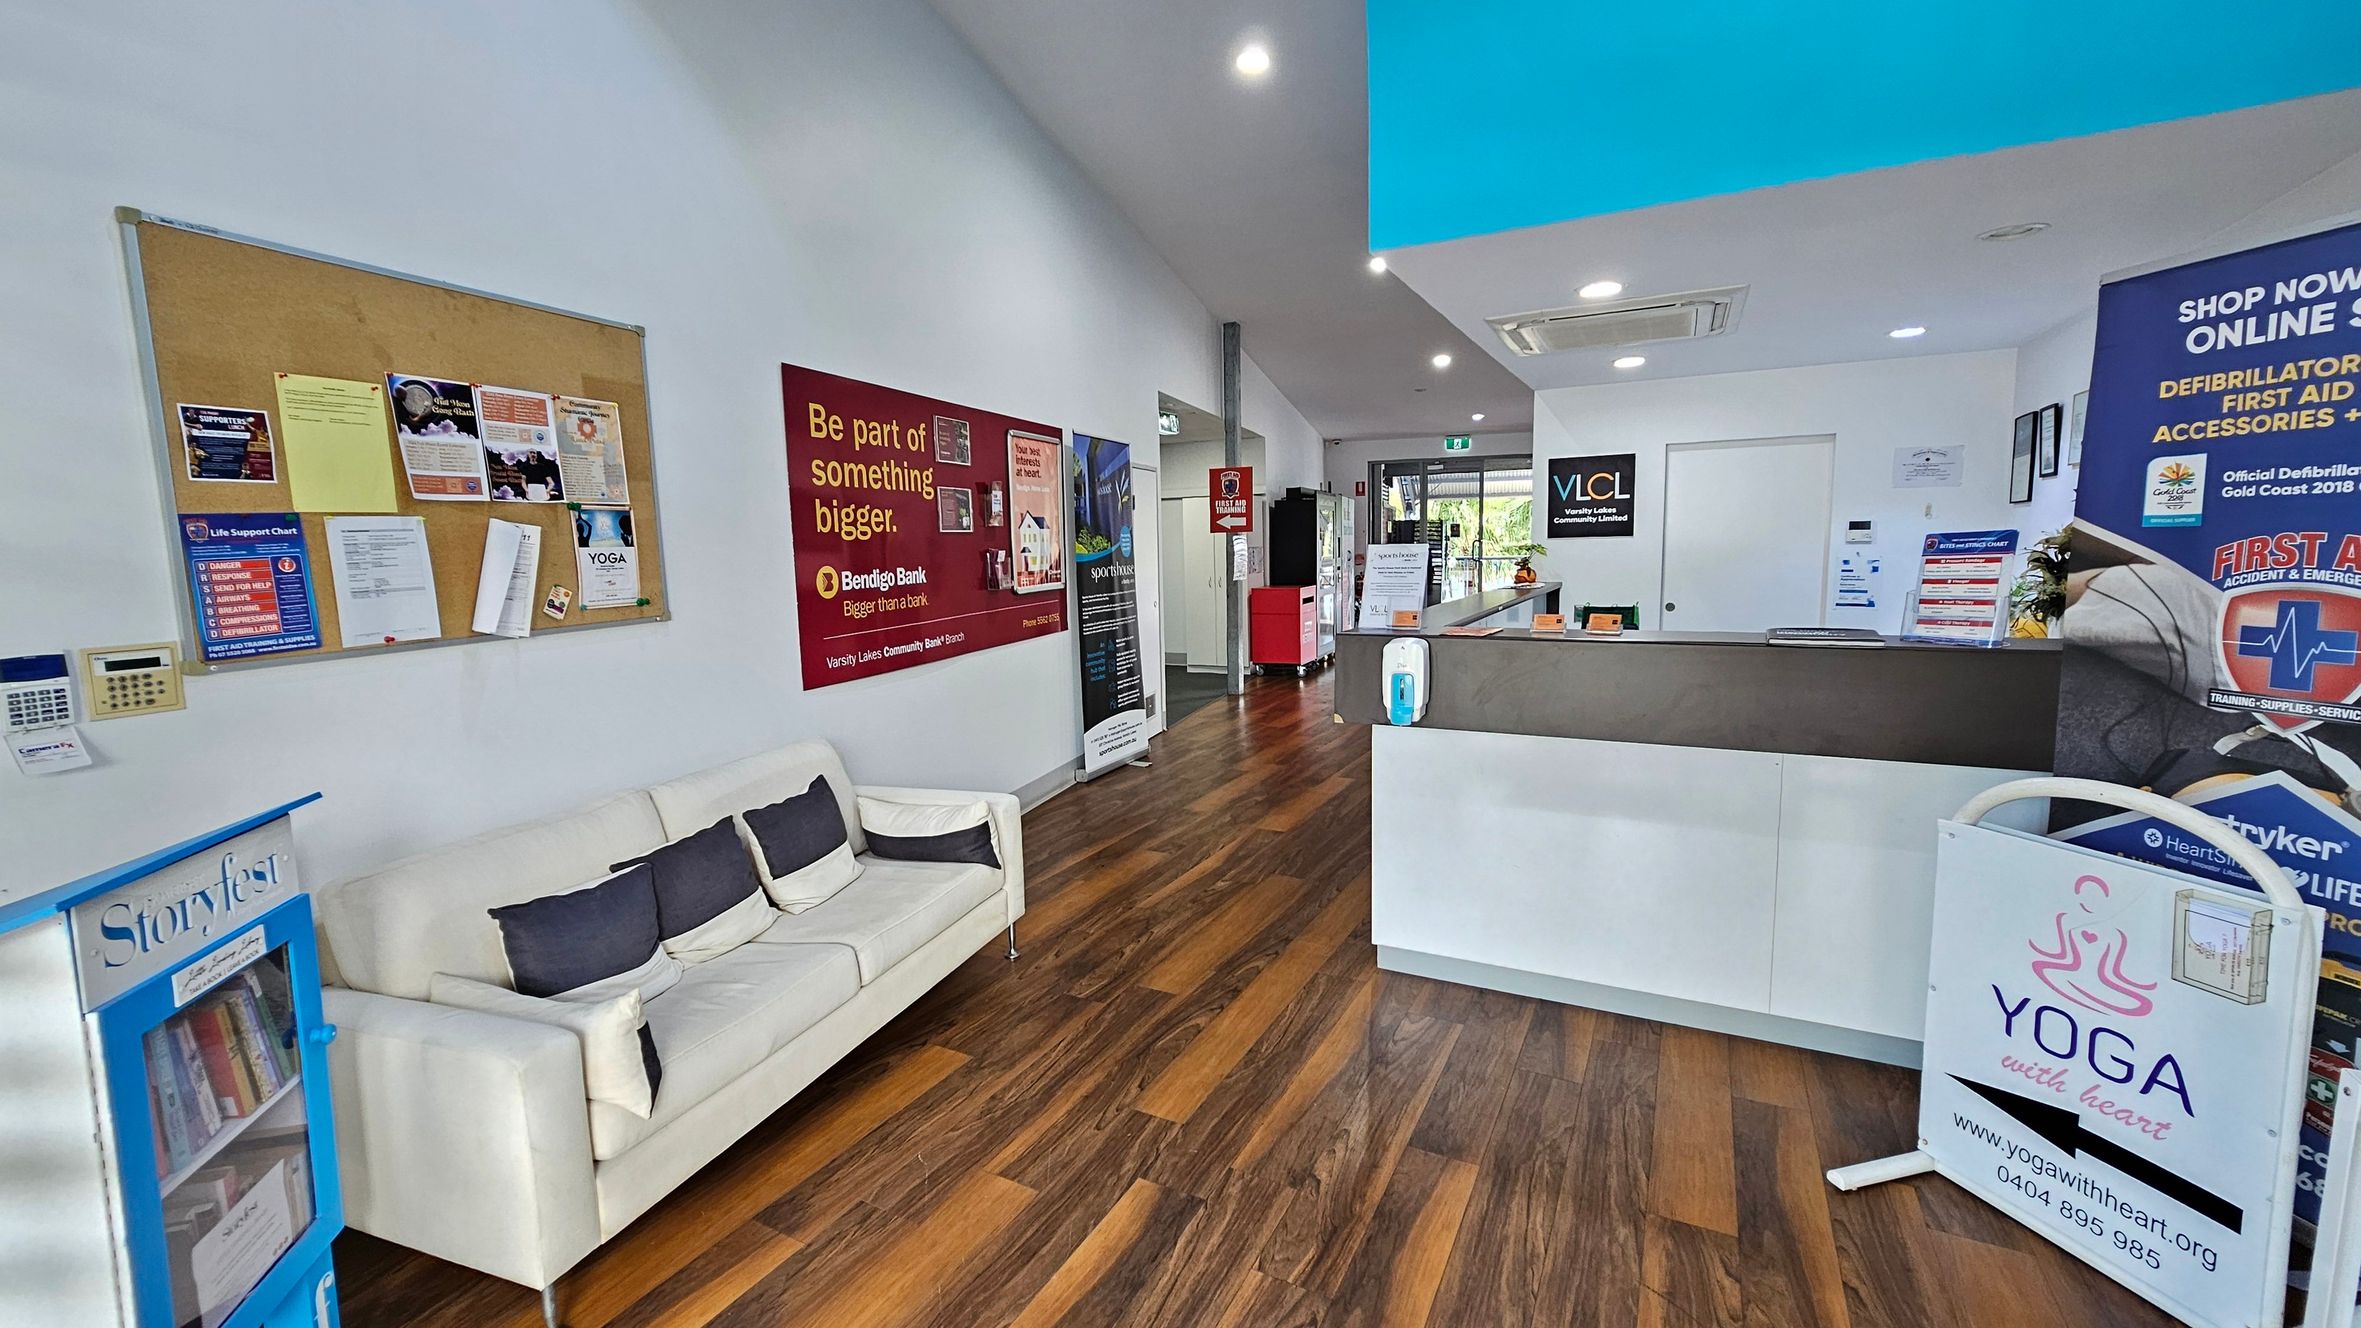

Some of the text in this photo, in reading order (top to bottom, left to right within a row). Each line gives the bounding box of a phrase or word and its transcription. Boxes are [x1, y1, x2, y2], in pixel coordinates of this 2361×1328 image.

[2178, 266, 2361, 323] SHOP NOW
[2185, 301, 2337, 354] ONLINE
[2159, 354, 2361, 399] DEFIBRILLATOR
[2222, 381, 2355, 414] FIRST AID
[199, 415, 247, 425] SUPPORTERS
[809, 402, 926, 452] Be part of
[2152, 408, 2335, 443] ACCESSORIES
[1015, 443, 1041, 457] Your best
[1015, 454, 1041, 467] interests
[811, 459, 934, 500] something
[1016, 468, 1023, 477] at
[2223, 468, 2276, 483] Official
[1553, 472, 1630, 501] VLCL
[2153, 487, 2197, 496] Gold Coast
[2221, 480, 2355, 498] Gold Coast 2018
[815, 498, 897, 541] bigger.
[1216, 506, 1246, 514] TRAINING
[210, 527, 298, 537] Life Support Chart
[209, 562, 241, 570] DANGER
[588, 553, 627, 564] YOGA
[2212, 532, 2329, 582] FIRST
[212, 572, 252, 580] RESPONSE
[841, 566, 927, 592] Bendigo Bank
[2223, 569, 2286, 589] ACCIDENT
[2289, 569, 2300, 580] &
[214, 584, 234, 592] SEND
[216, 594, 250, 603] AIRWAYS
[843, 592, 928, 619] Bigger than a bank
[218, 605, 260, 614] BREATHING
[209, 614, 278, 627] C COMPRESSIONS
[222, 624, 278, 636] DEFIBRILLATOR
[1023, 619, 1037, 628] Phone
[208, 644, 229, 652] FIRST
[230, 642, 243, 650] AID
[244, 638, 278, 648] TRAINING
[285, 635, 315, 644] SUPPLIES
[826, 653, 857, 669] Varsity
[858, 649, 882, 663] Lakes
[883, 641, 924, 657] Community
[945, 631, 965, 645] Branch
[2210, 693, 2256, 707] TRAINING
[2260, 699, 2313, 714] SUPPLIES
[2211, 815, 2343, 861] tryker
[2165, 853, 2189, 864] Inventor
[2191, 859, 2221, 873] Innovator
[2311, 873, 2361, 907] LIFE
[101, 852, 279, 968] Storyfest
[1991, 983, 2195, 1118] YOGA
[2001, 1055, 2173, 1141] with heart
[1953, 1112, 2218, 1273] www.yogawithheart.org
[1997, 1165, 2161, 1270] 0404 895 985
